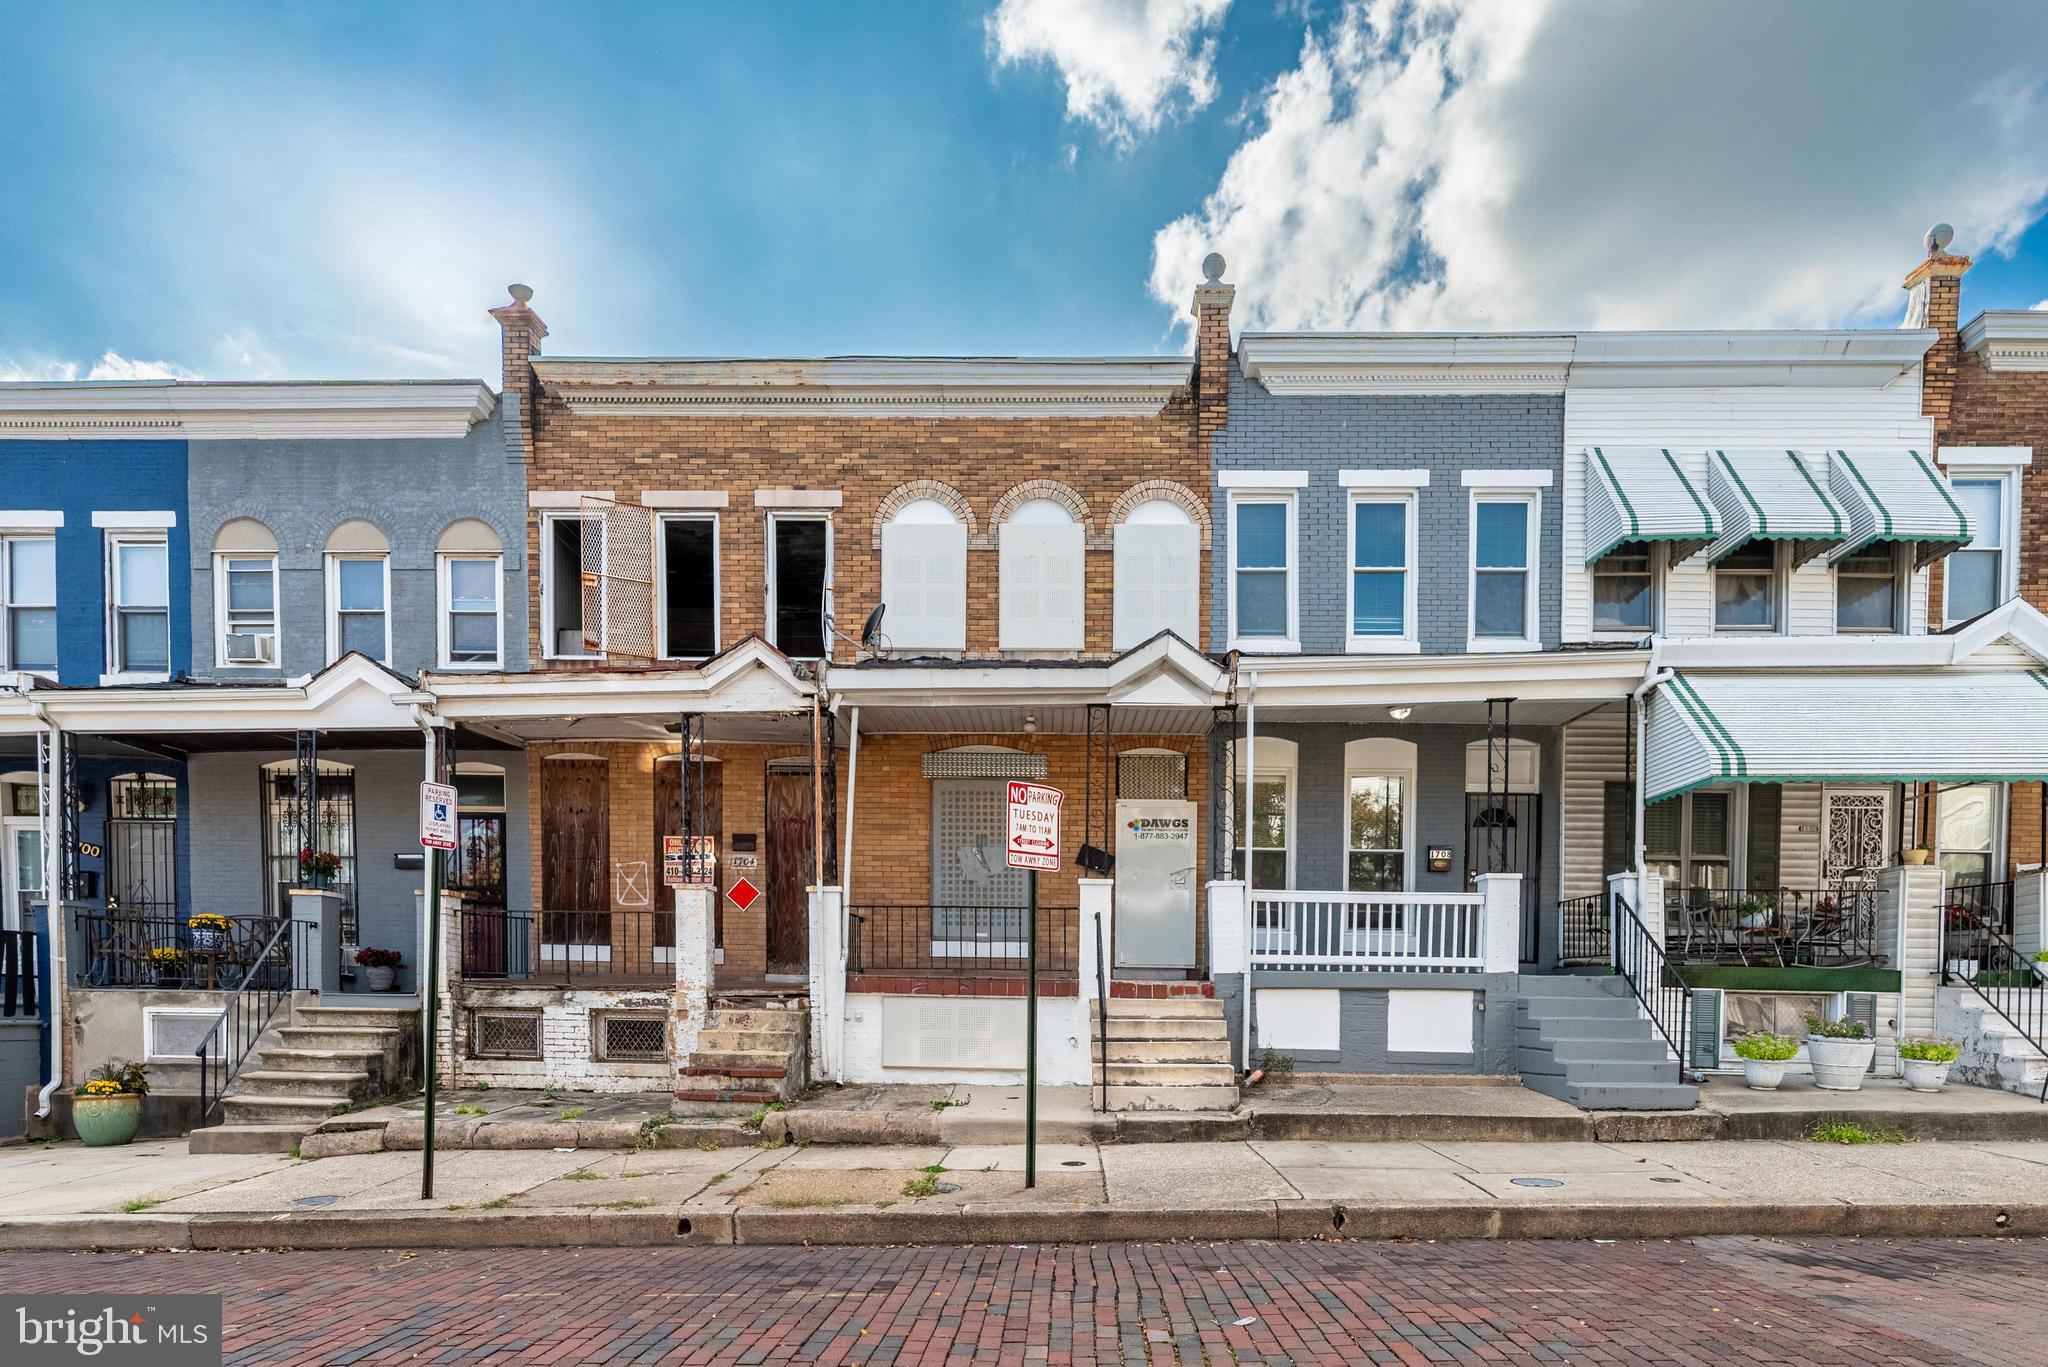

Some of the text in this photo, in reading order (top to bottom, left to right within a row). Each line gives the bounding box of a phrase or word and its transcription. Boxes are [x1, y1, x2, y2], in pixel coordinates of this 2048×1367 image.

[427, 787, 450, 798] PARKING
[1010, 785, 1059, 806] NO PARKING
[425, 794, 453, 805] RESERVED
[1013, 808, 1055, 823] TUESDAY
[1140, 819, 1189, 828] DAWGS
[1015, 823, 1052, 836] 7AM TO 11AM
[1134, 832, 1189, 840] 1-877-883-2947
[733, 857, 755, 866] 1704
[1010, 853, 1057, 867] TOW AWAY ZONE
